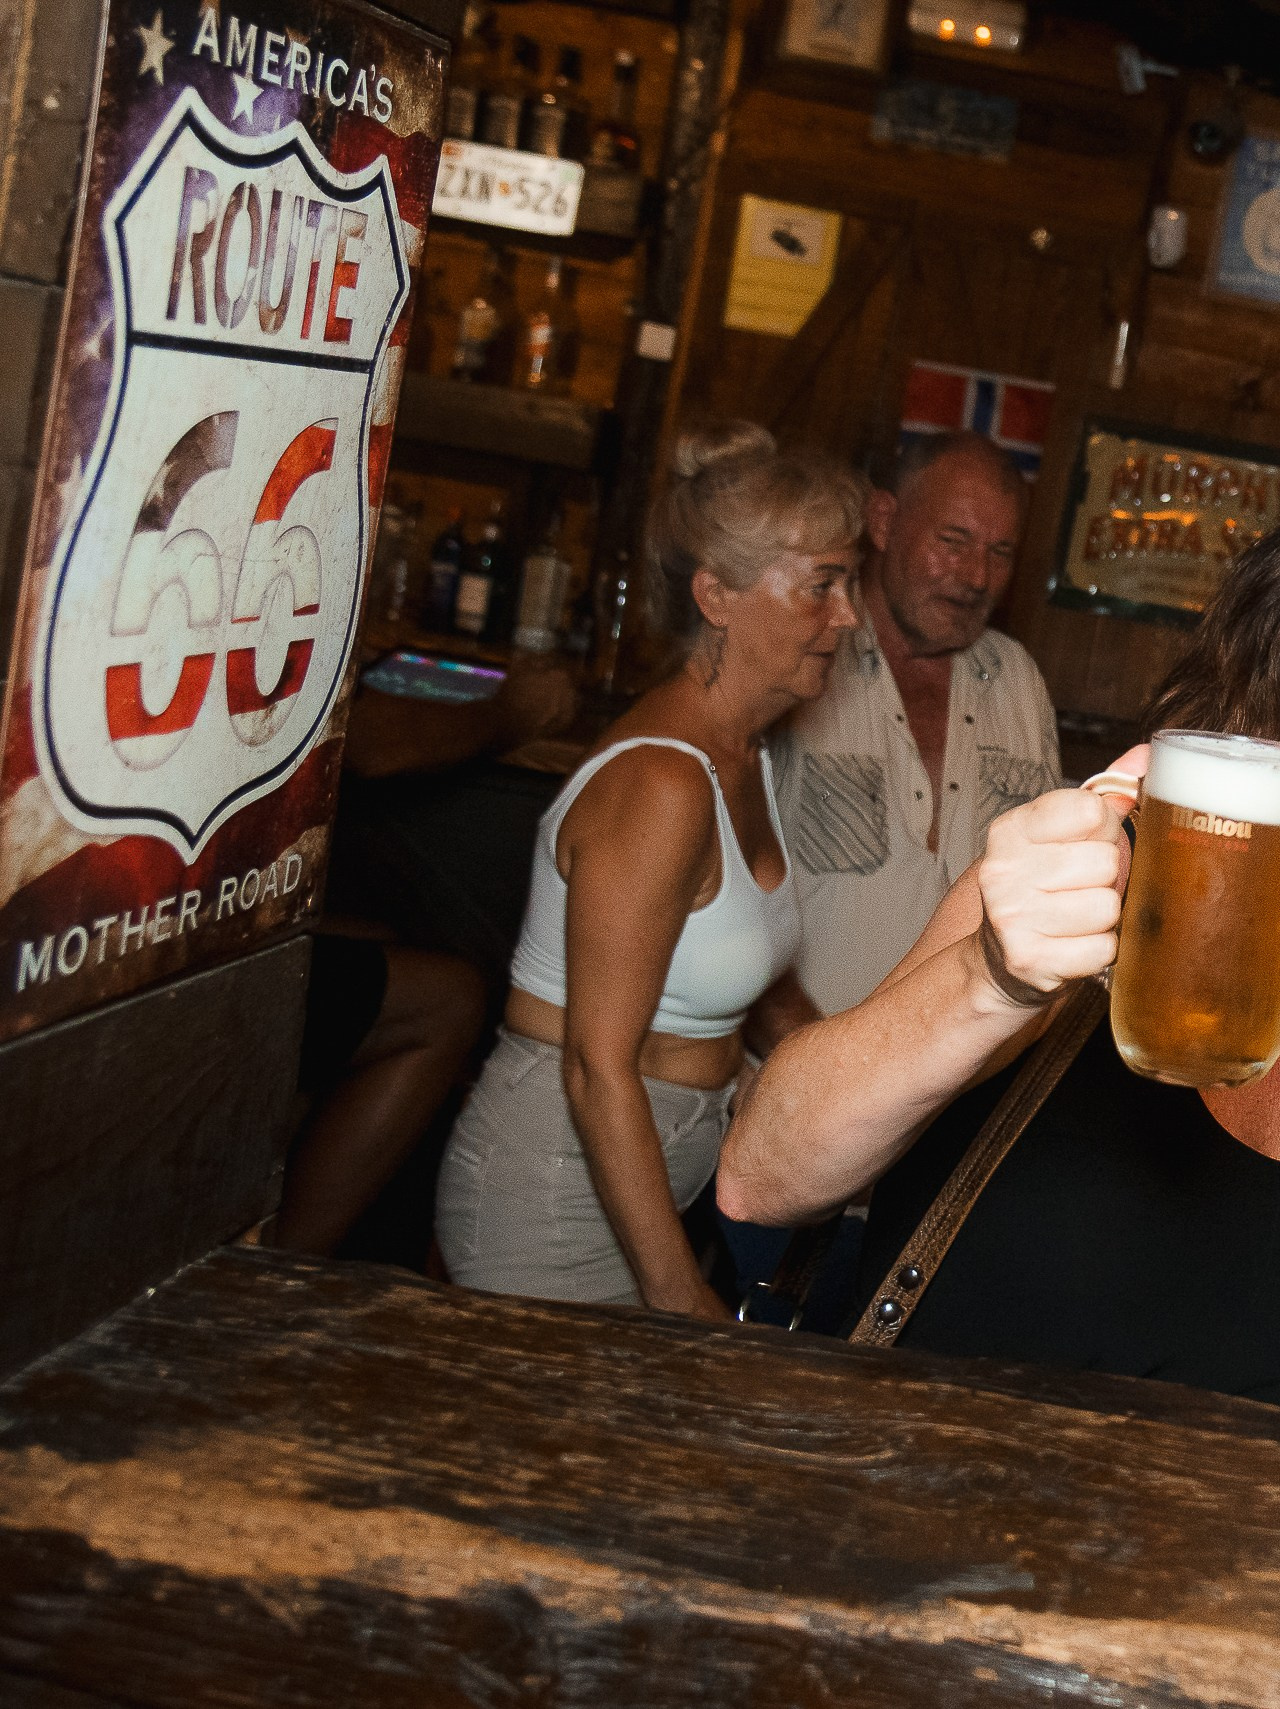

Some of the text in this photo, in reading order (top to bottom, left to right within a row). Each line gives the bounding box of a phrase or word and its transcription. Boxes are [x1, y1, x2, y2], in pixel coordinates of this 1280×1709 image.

[191, 6, 395, 124] AMERICA'S
[165, 165, 370, 345] ROUTE
[513, 175, 569, 218] 526
[104, 409, 340, 772] 66
[1083, 511, 1205, 561] EXTRA
[15, 853, 303, 994] MOTHER ROAD
